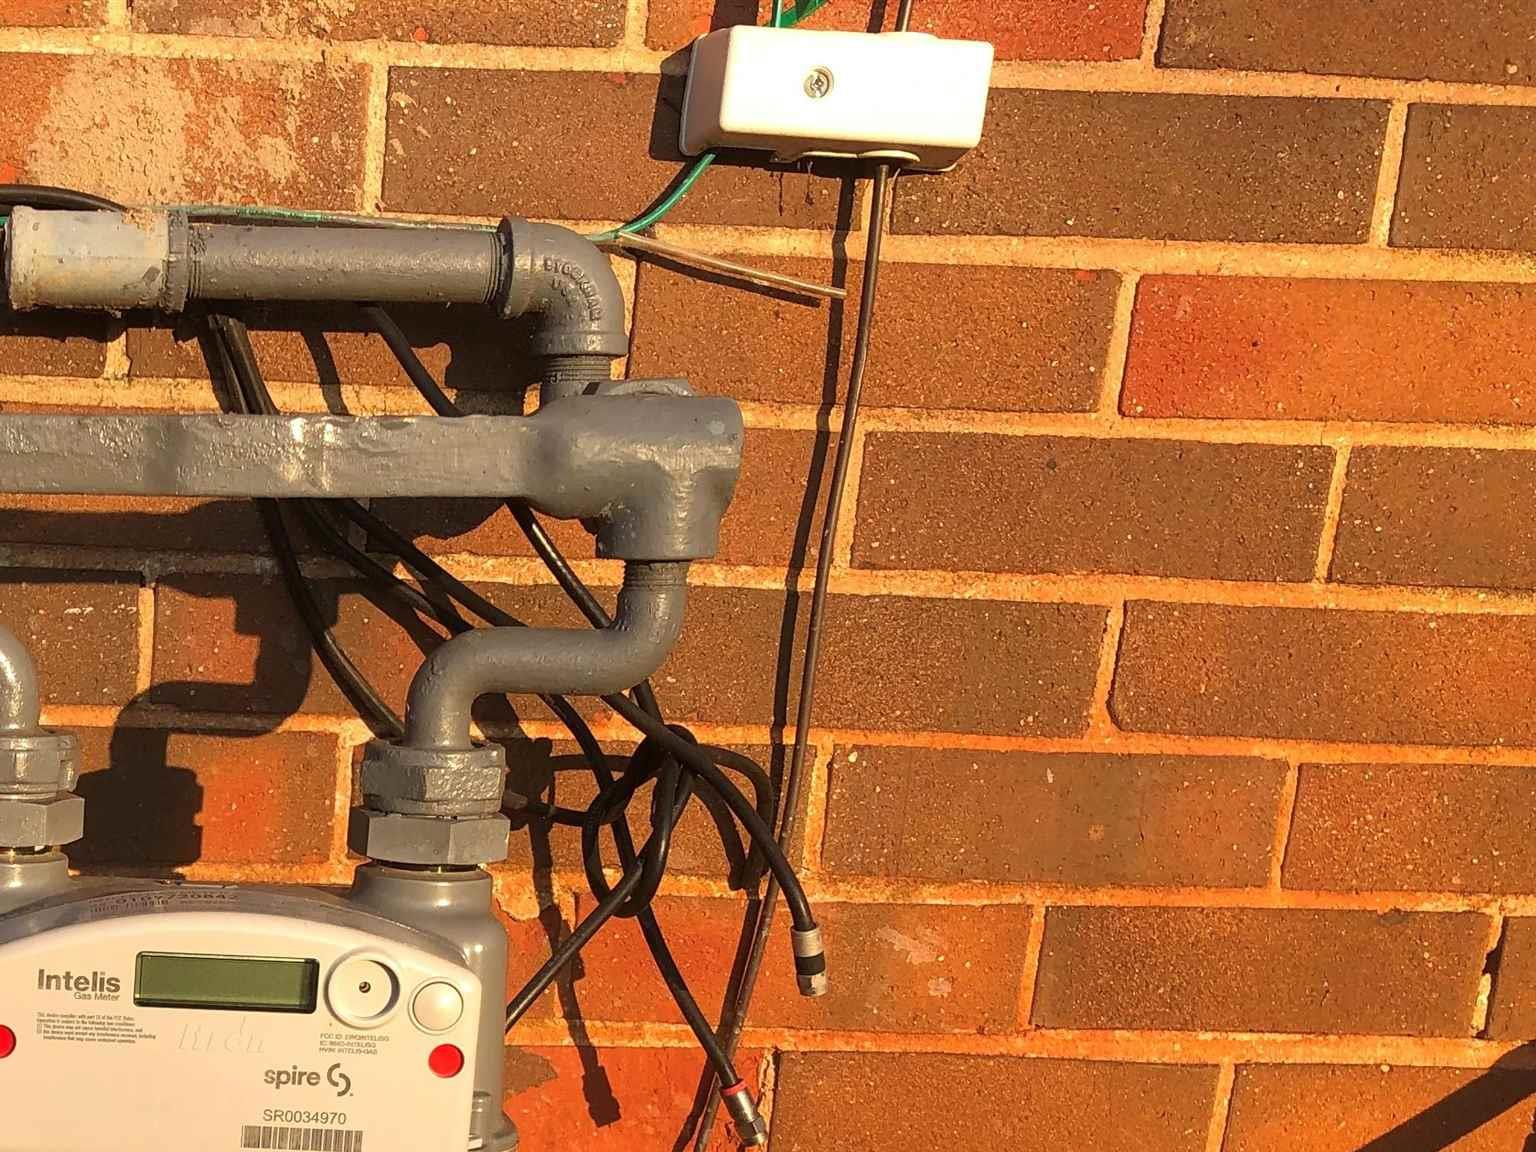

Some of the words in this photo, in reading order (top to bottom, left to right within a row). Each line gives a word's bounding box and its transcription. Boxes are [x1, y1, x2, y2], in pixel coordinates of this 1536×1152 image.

[38, 968, 121, 993] Intelis
[74, 991, 92, 1000] Gas
[94, 993, 121, 1001] Meter
[263, 1065, 321, 1090] spire
[262, 1108, 347, 1125] SR0034970
